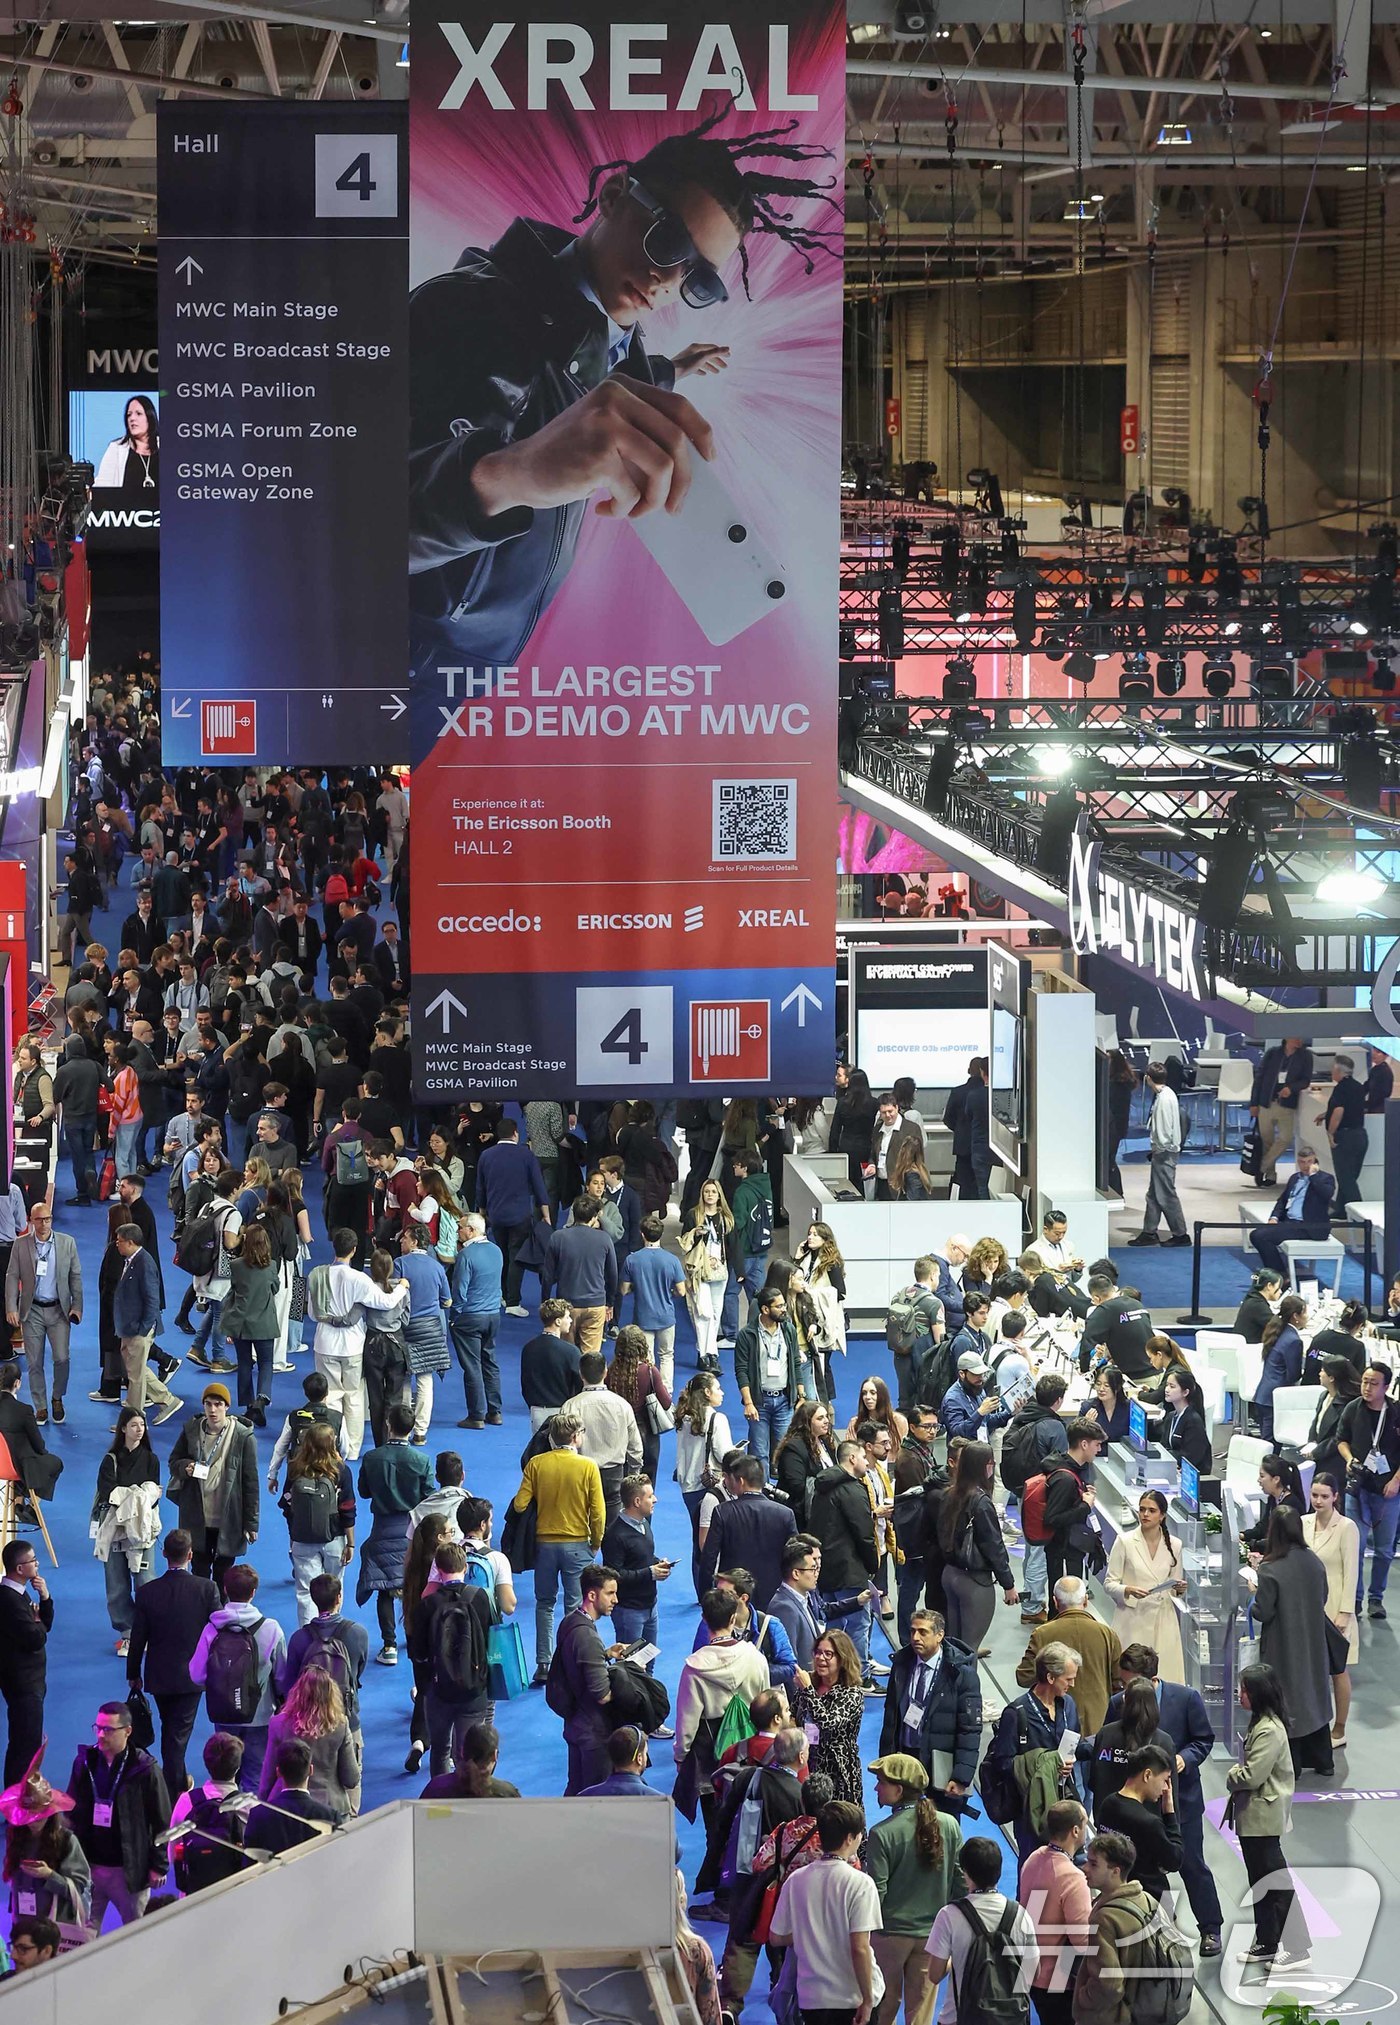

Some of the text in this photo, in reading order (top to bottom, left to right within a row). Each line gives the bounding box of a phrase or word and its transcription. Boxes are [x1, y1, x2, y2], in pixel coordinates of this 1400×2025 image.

[437, 22, 819, 112] XREAL
[174, 134, 218, 153] Hall
[335, 152, 377, 201] 4
[177, 302, 338, 320] MWC Main Stage
[177, 342, 391, 360] MWC Broadcast Stage
[177, 382, 315, 397] GSMA Pavilion
[177, 423, 357, 438] GSMA Forum Zone
[177, 463, 292, 480] GSMA Open
[177, 485, 314, 502] Gateway Zone
[437, 665, 721, 697] THE LARGEST
[437, 703, 810, 737] XR DEMO AT MWC
[453, 798, 545, 811] Experience it at:
[452, 815, 611, 830] The Ericsson Booth
[455, 840, 512, 855] HALL 2
[578, 914, 672, 929] ERICSSON
[738, 909, 809, 927] XREAL
[600, 1008, 648, 1065] 4
[426, 1043, 532, 1054] MWC Main Stage
[877, 1045, 920, 1053] DISCOVER
[940, 1044, 979, 1052] mPOWER
[426, 1059, 566, 1071] MWC Broadcast Stage
[426, 1077, 517, 1089] GSMA Pavilion
